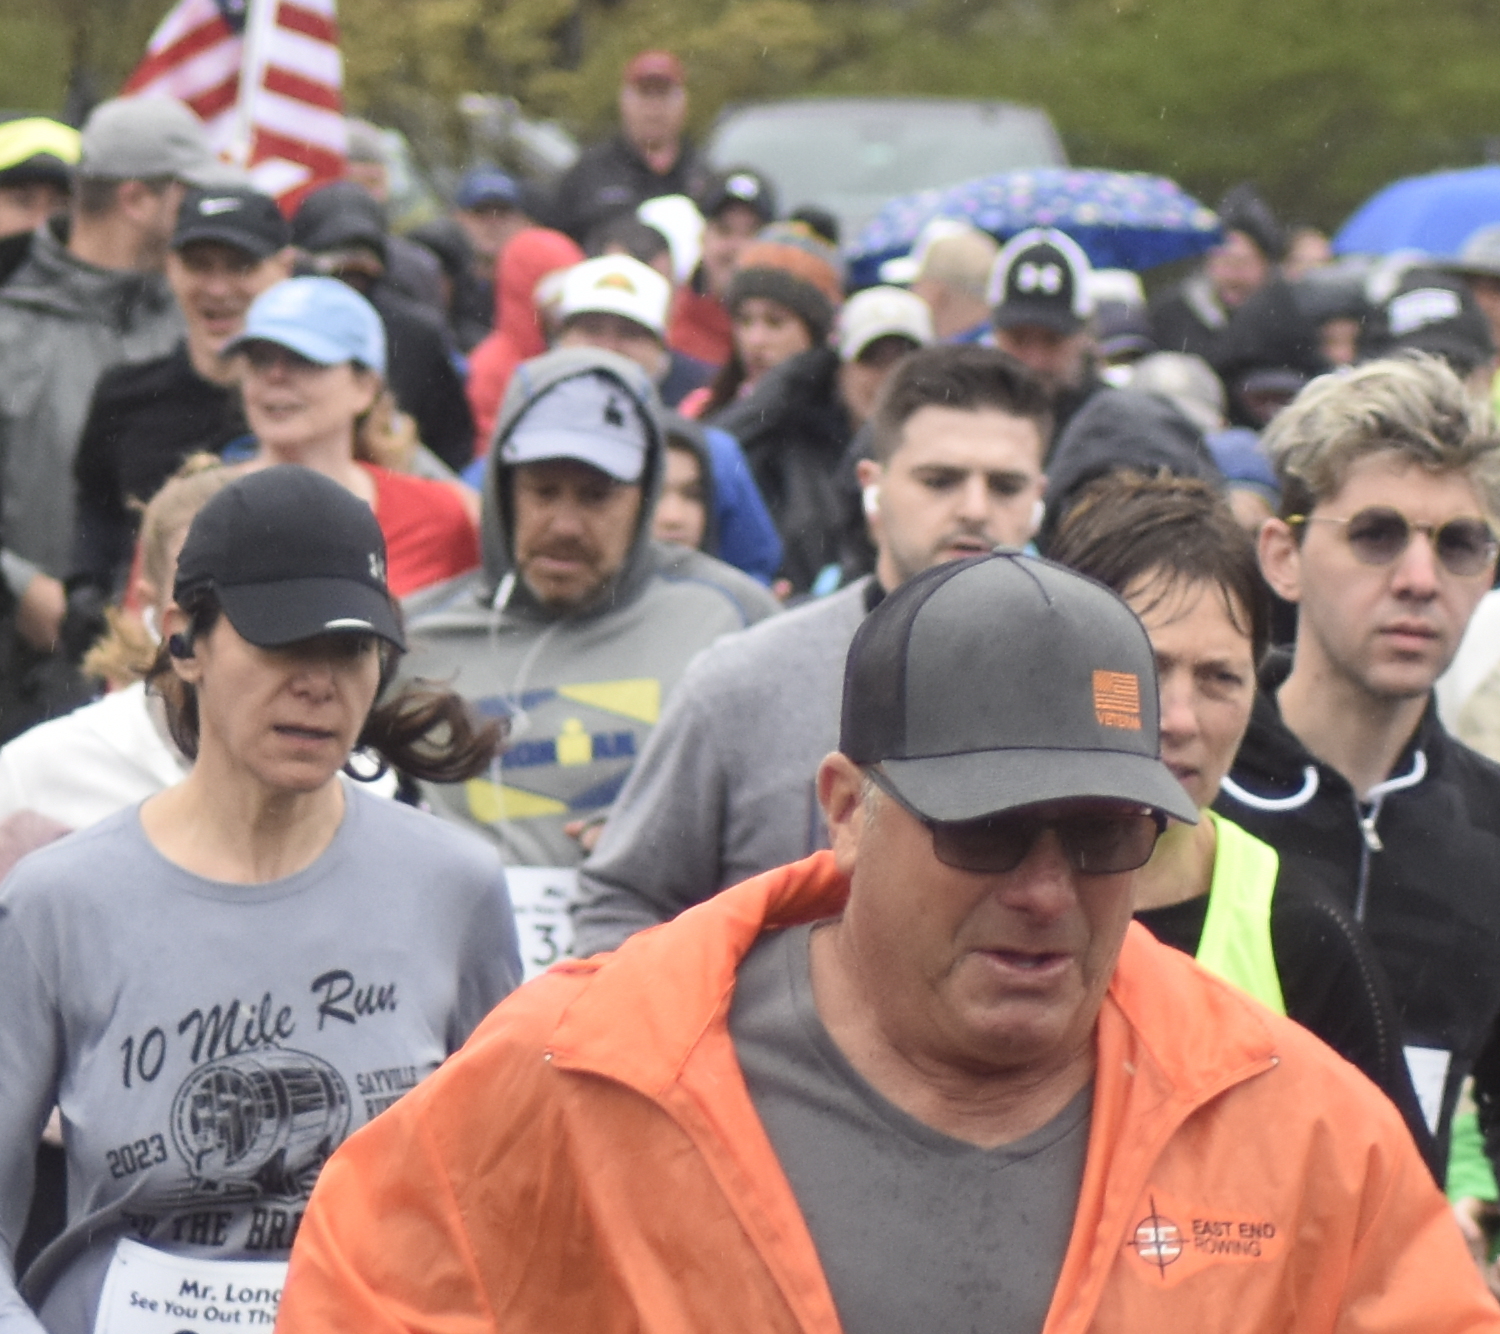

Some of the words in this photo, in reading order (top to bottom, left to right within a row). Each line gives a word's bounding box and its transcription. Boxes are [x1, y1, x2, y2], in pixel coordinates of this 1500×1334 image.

[120, 1027, 166, 1088] 10
[178, 992, 296, 1063] Mile
[311, 969, 398, 1031] Run
[106, 1133, 168, 1179] 2023
[173, 1211, 233, 1247] THE
[1192, 1219, 1232, 1237] EAST
[1239, 1223, 1276, 1239] END
[1195, 1237, 1262, 1257] ROWING
[179, 1279, 216, 1301] Mr.
[130, 1291, 158, 1311] See
[164, 1300, 198, 1319] You
[203, 1305, 242, 1323] Out
